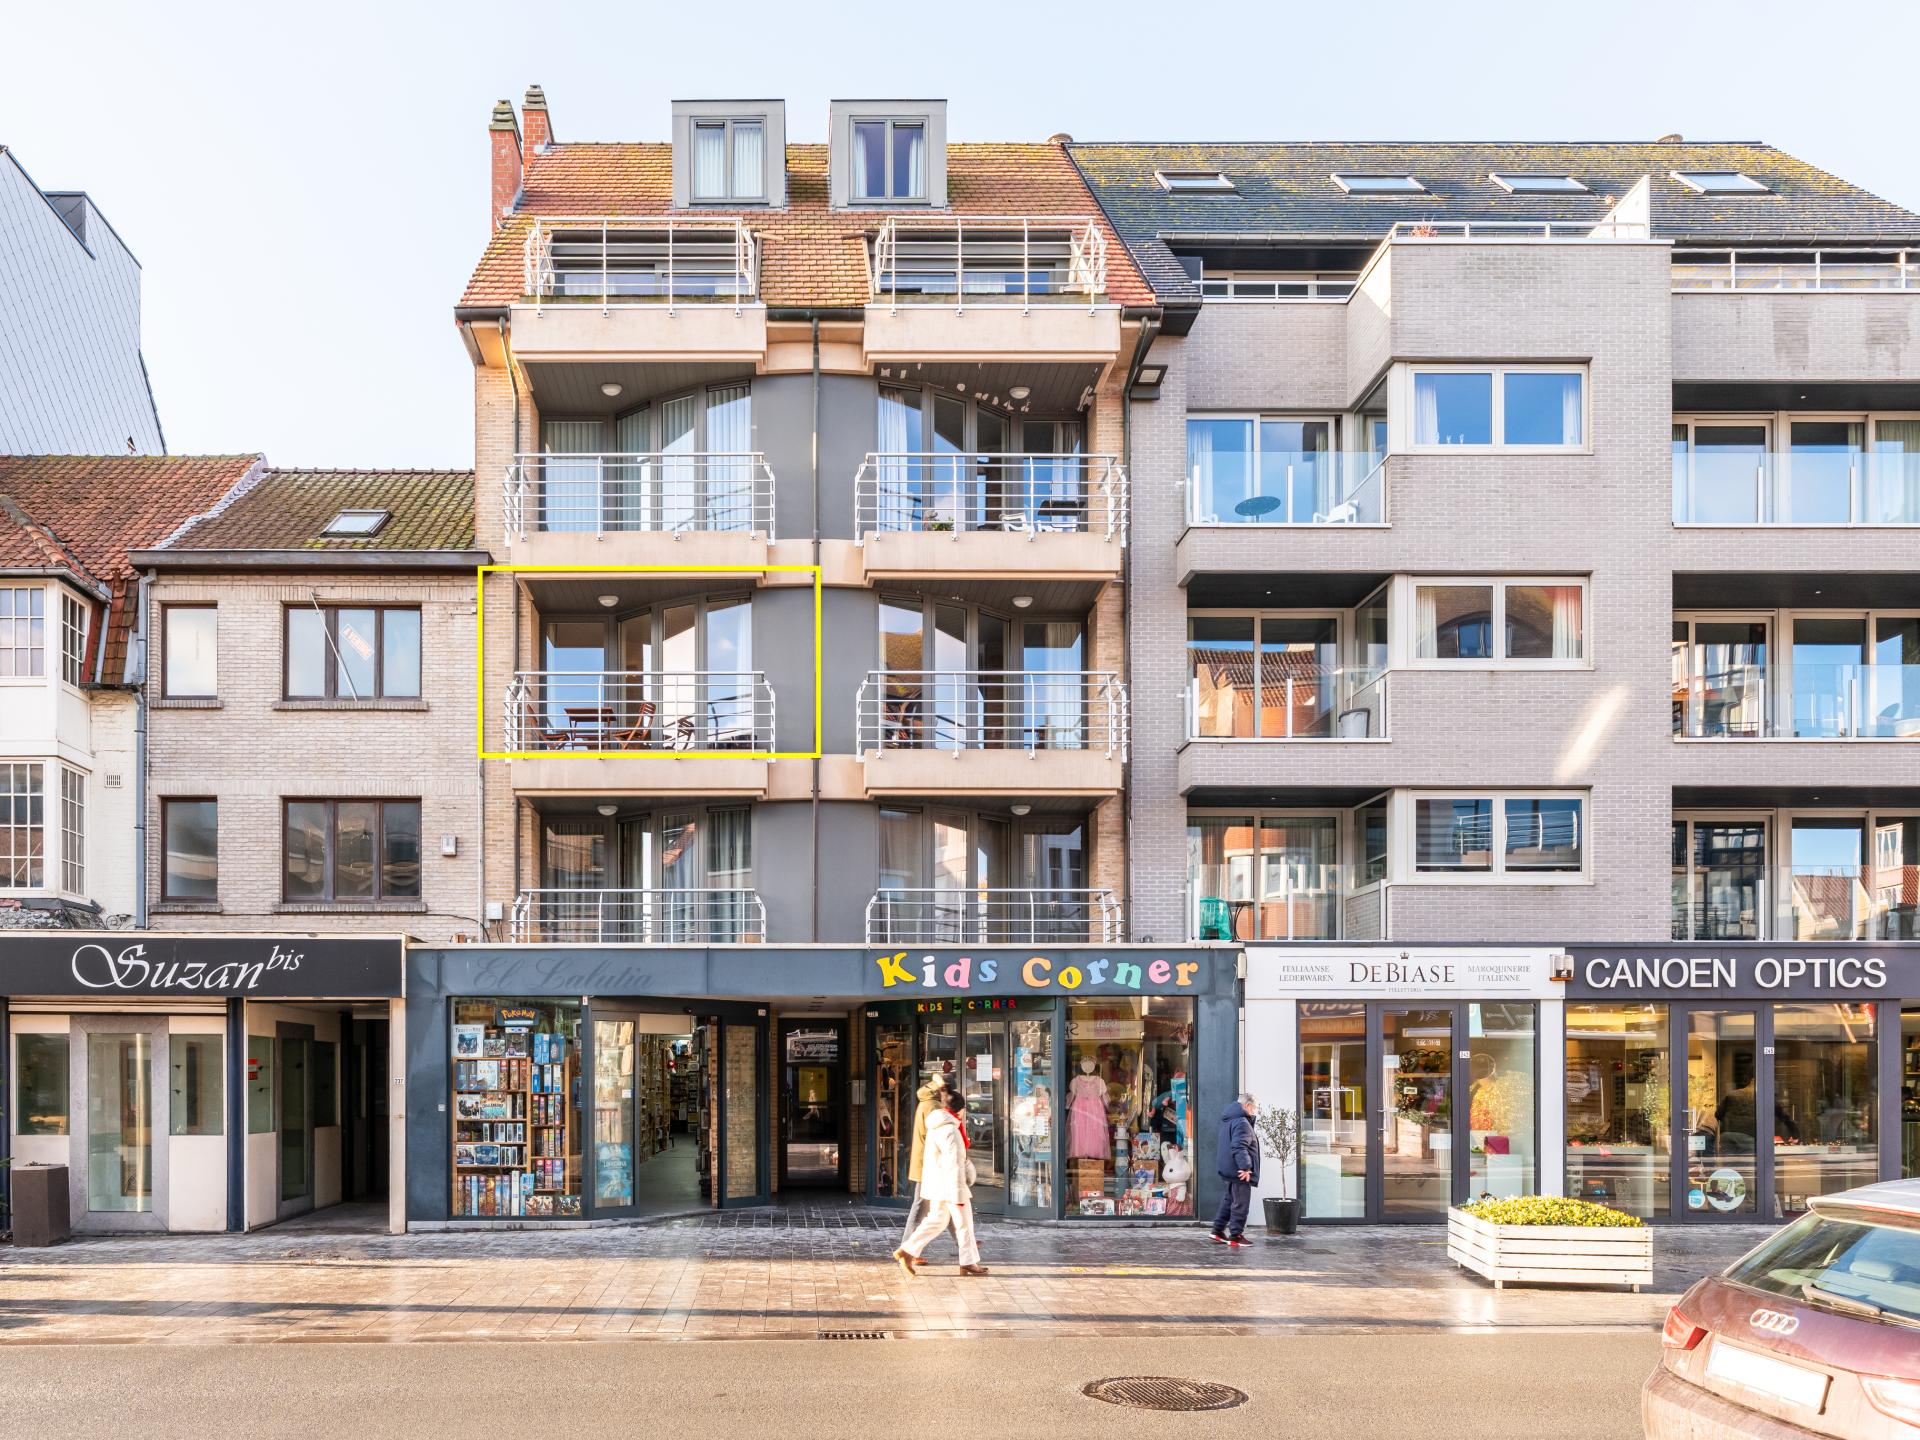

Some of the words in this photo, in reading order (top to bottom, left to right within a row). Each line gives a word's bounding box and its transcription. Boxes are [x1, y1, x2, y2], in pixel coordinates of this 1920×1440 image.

[71, 943, 264, 989] Suzan
[266, 945, 304, 970] bis
[876, 952, 998, 989] Kids
[1022, 957, 1199, 989] Corner
[1282, 965, 1330, 973] ITALIAANSE
[1467, 965, 1532, 973] MAROQUINERIE
[1279, 974, 1334, 982] LEDERWAREN
[1478, 974, 1521, 982] ITALIENNE
[1585, 958, 1736, 989] CANOEN
[1754, 958, 1887, 989] OPTICS
[917, 1002, 943, 1012] KIDS
[968, 998, 1017, 1010] CORNER
